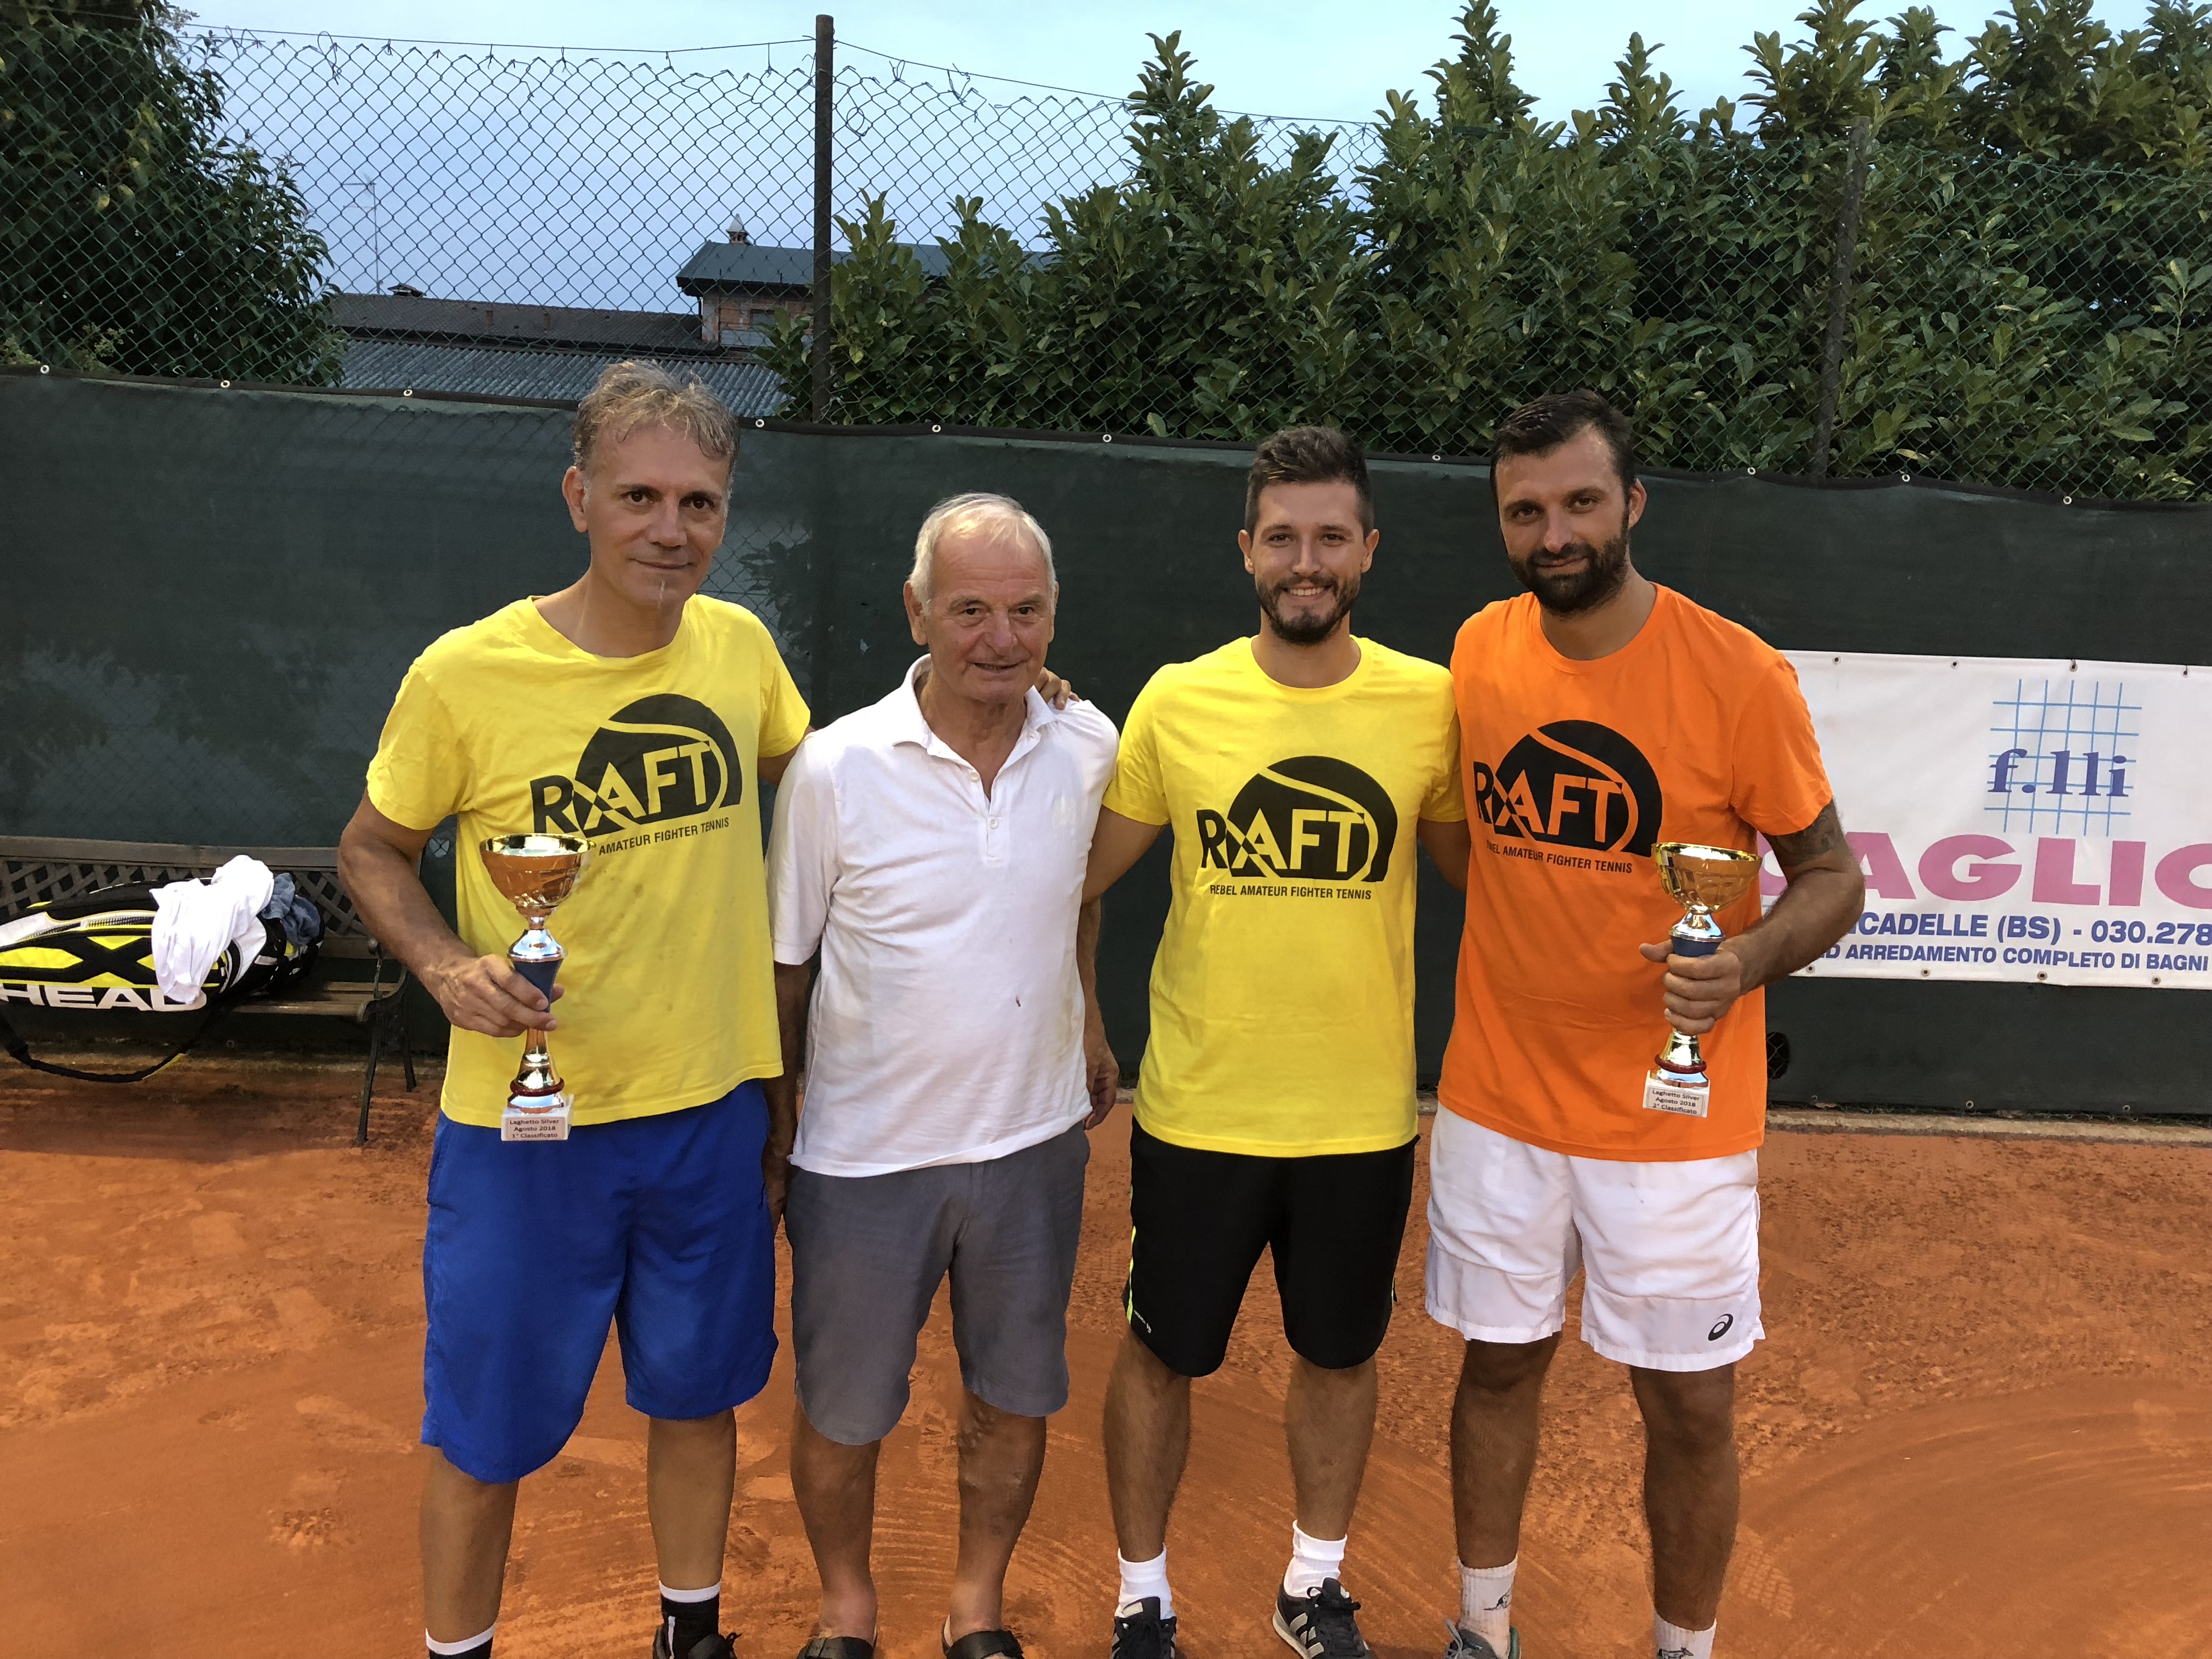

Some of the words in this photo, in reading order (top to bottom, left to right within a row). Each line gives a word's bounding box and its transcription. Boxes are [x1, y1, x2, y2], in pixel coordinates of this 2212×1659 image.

[529, 740, 711, 834] RAFT
[1987, 748, 2130, 797] f.lli
[1472, 761, 1623, 843] RAFT
[599, 834, 651, 856] AMATEUR
[654, 826, 698, 841] FIGHTER
[701, 817, 730, 833] TENNIS
[1196, 808, 1365, 873] RAFT
[1503, 845, 1544, 861] AMATEUR
[1547, 853, 1592, 869] FIGHTER
[1595, 860, 1632, 873] TENNIS
[1210, 885, 1238, 896] REBEL
[1240, 885, 1288, 896] AMATEUR
[1291, 887, 1333, 898] FIGHTER
[1336, 888, 1372, 900] TENNIS
[1847, 912, 1989, 938] CADELLE
[1997, 915, 2061, 946] (BS)
[2091, 919, 2212, 946] 030.278
[1845, 945, 1997, 963] ARREDAMENTO
[2003, 947, 2115, 968] COMPLETO
[2121, 953, 2140, 968] DI
[2146, 953, 2208, 971] BAGNI
[0, 983, 207, 1012] HEAD
[1652, 1090, 1680, 1098] Laghetto
[1661, 1105, 1697, 1114] Classificato
